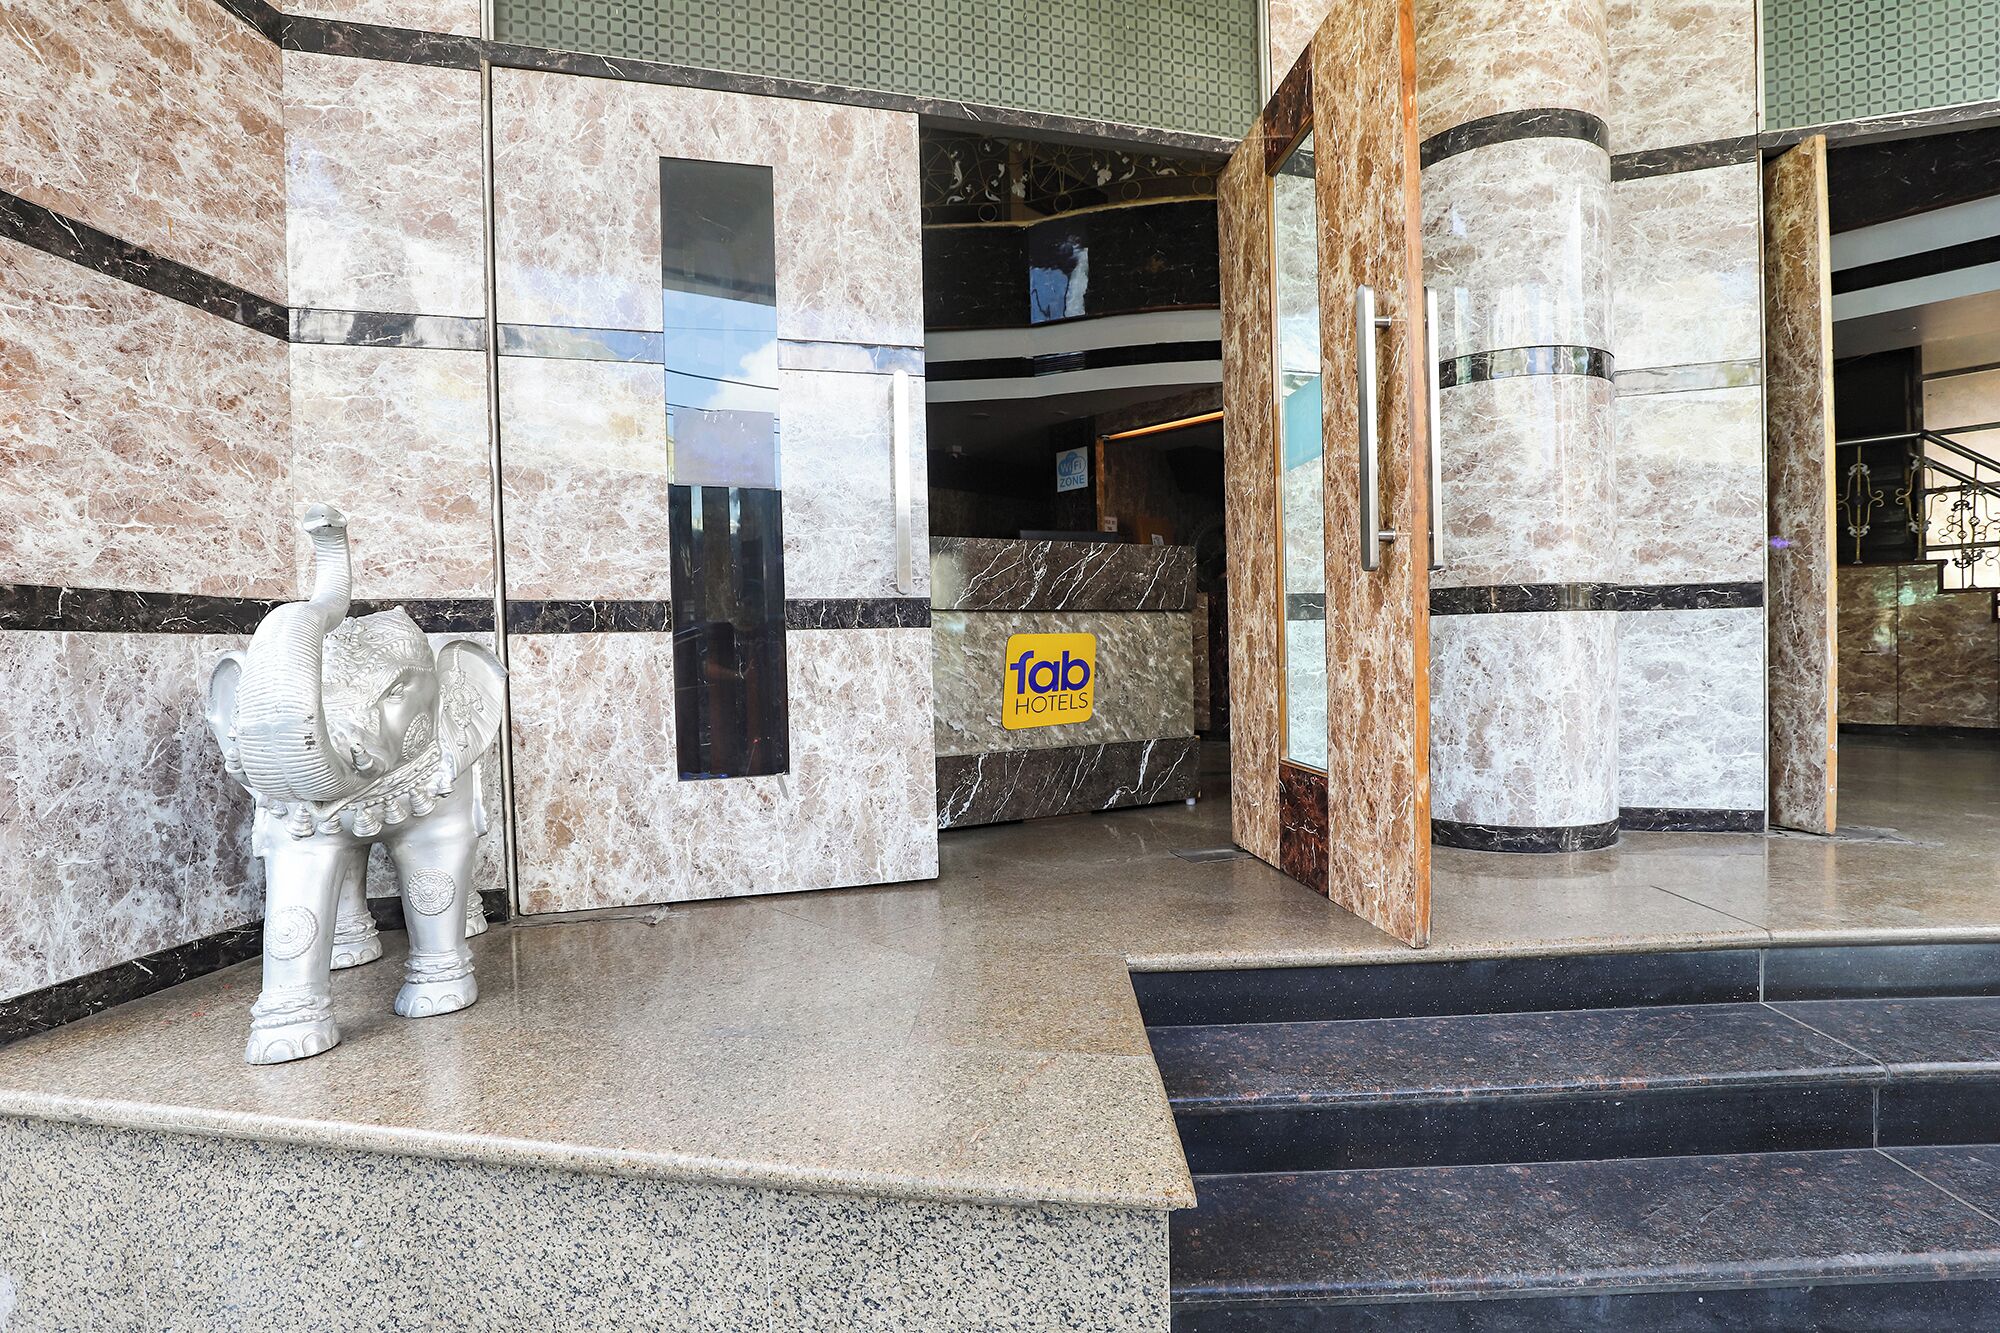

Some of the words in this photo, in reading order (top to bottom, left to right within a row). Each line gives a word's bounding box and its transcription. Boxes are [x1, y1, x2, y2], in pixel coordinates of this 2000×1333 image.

[1060, 474, 1085, 488] ZONE
[1010, 650, 1090, 694] fab
[1015, 692, 1088, 715] HOTELS
